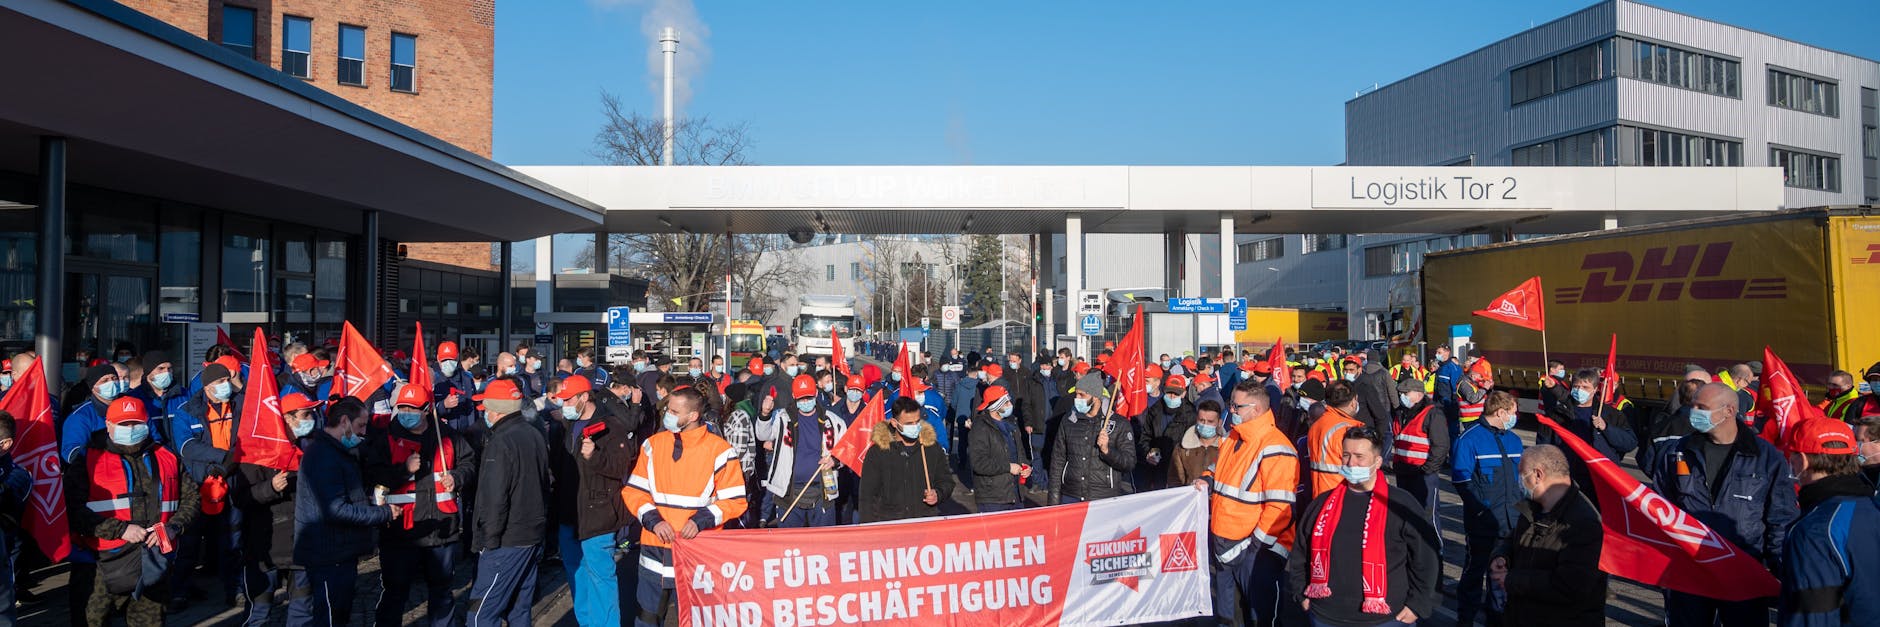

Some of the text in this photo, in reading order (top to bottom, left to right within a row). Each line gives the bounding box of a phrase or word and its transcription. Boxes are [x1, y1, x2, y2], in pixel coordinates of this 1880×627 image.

[1351, 176, 1517, 205] Logistik Tor 2
[1580, 241, 1747, 303] DHL
[1178, 298, 1203, 307] Logistik
[1231, 299, 1240, 313] P
[610, 309, 620, 324] P
[1088, 539, 1145, 557] ZUKUNFT
[692, 535, 1046, 595] 4 % FÜR EINKOMMEN
[1091, 553, 1151, 573] SICHERN.
[691, 575, 1053, 627] UND BESCHÄFTIGUNG
